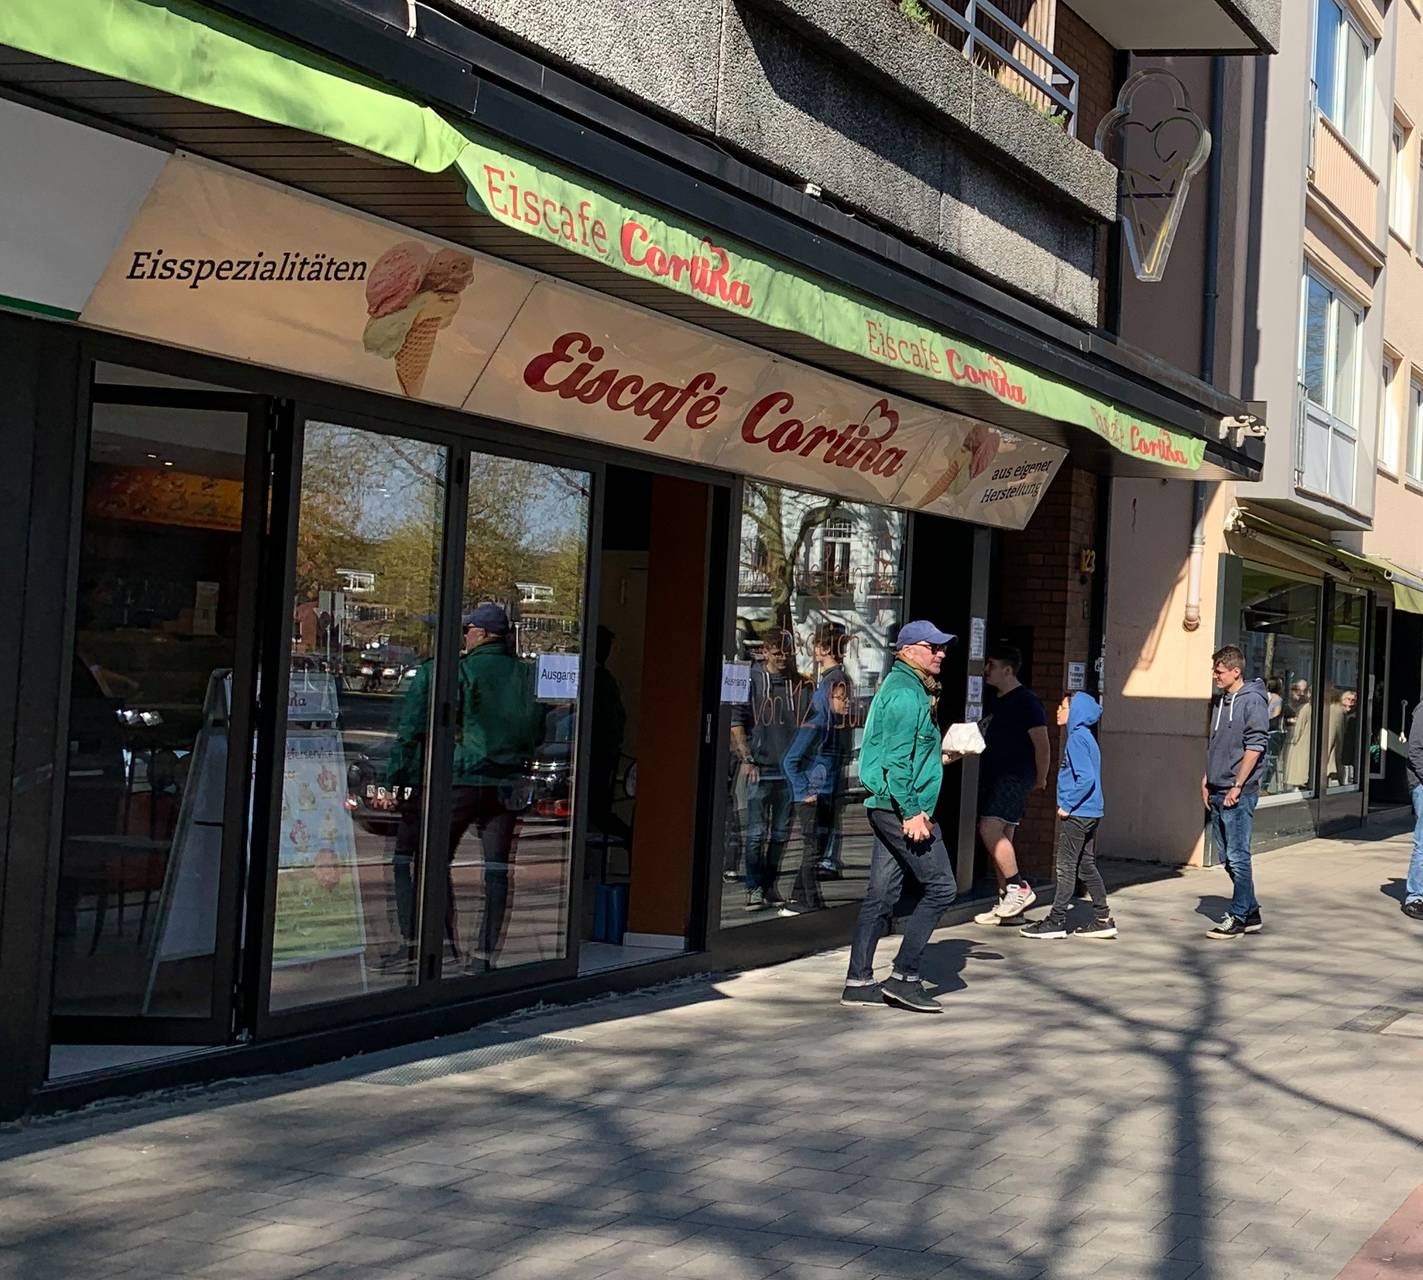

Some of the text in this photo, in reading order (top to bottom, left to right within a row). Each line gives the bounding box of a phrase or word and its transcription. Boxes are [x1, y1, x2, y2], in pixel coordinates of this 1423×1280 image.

[484, 164, 753, 308] Eiscafe Cortina
[127, 249, 367, 289] Eisspezialitäten
[866, 320, 1027, 404] Eiscafe Cortina
[524, 332, 908, 478] Eiscafé Cortina
[992, 459, 1053, 481] aus eigener
[981, 481, 1042, 503] Herstellung
[541, 667, 576, 684] Ausgang
